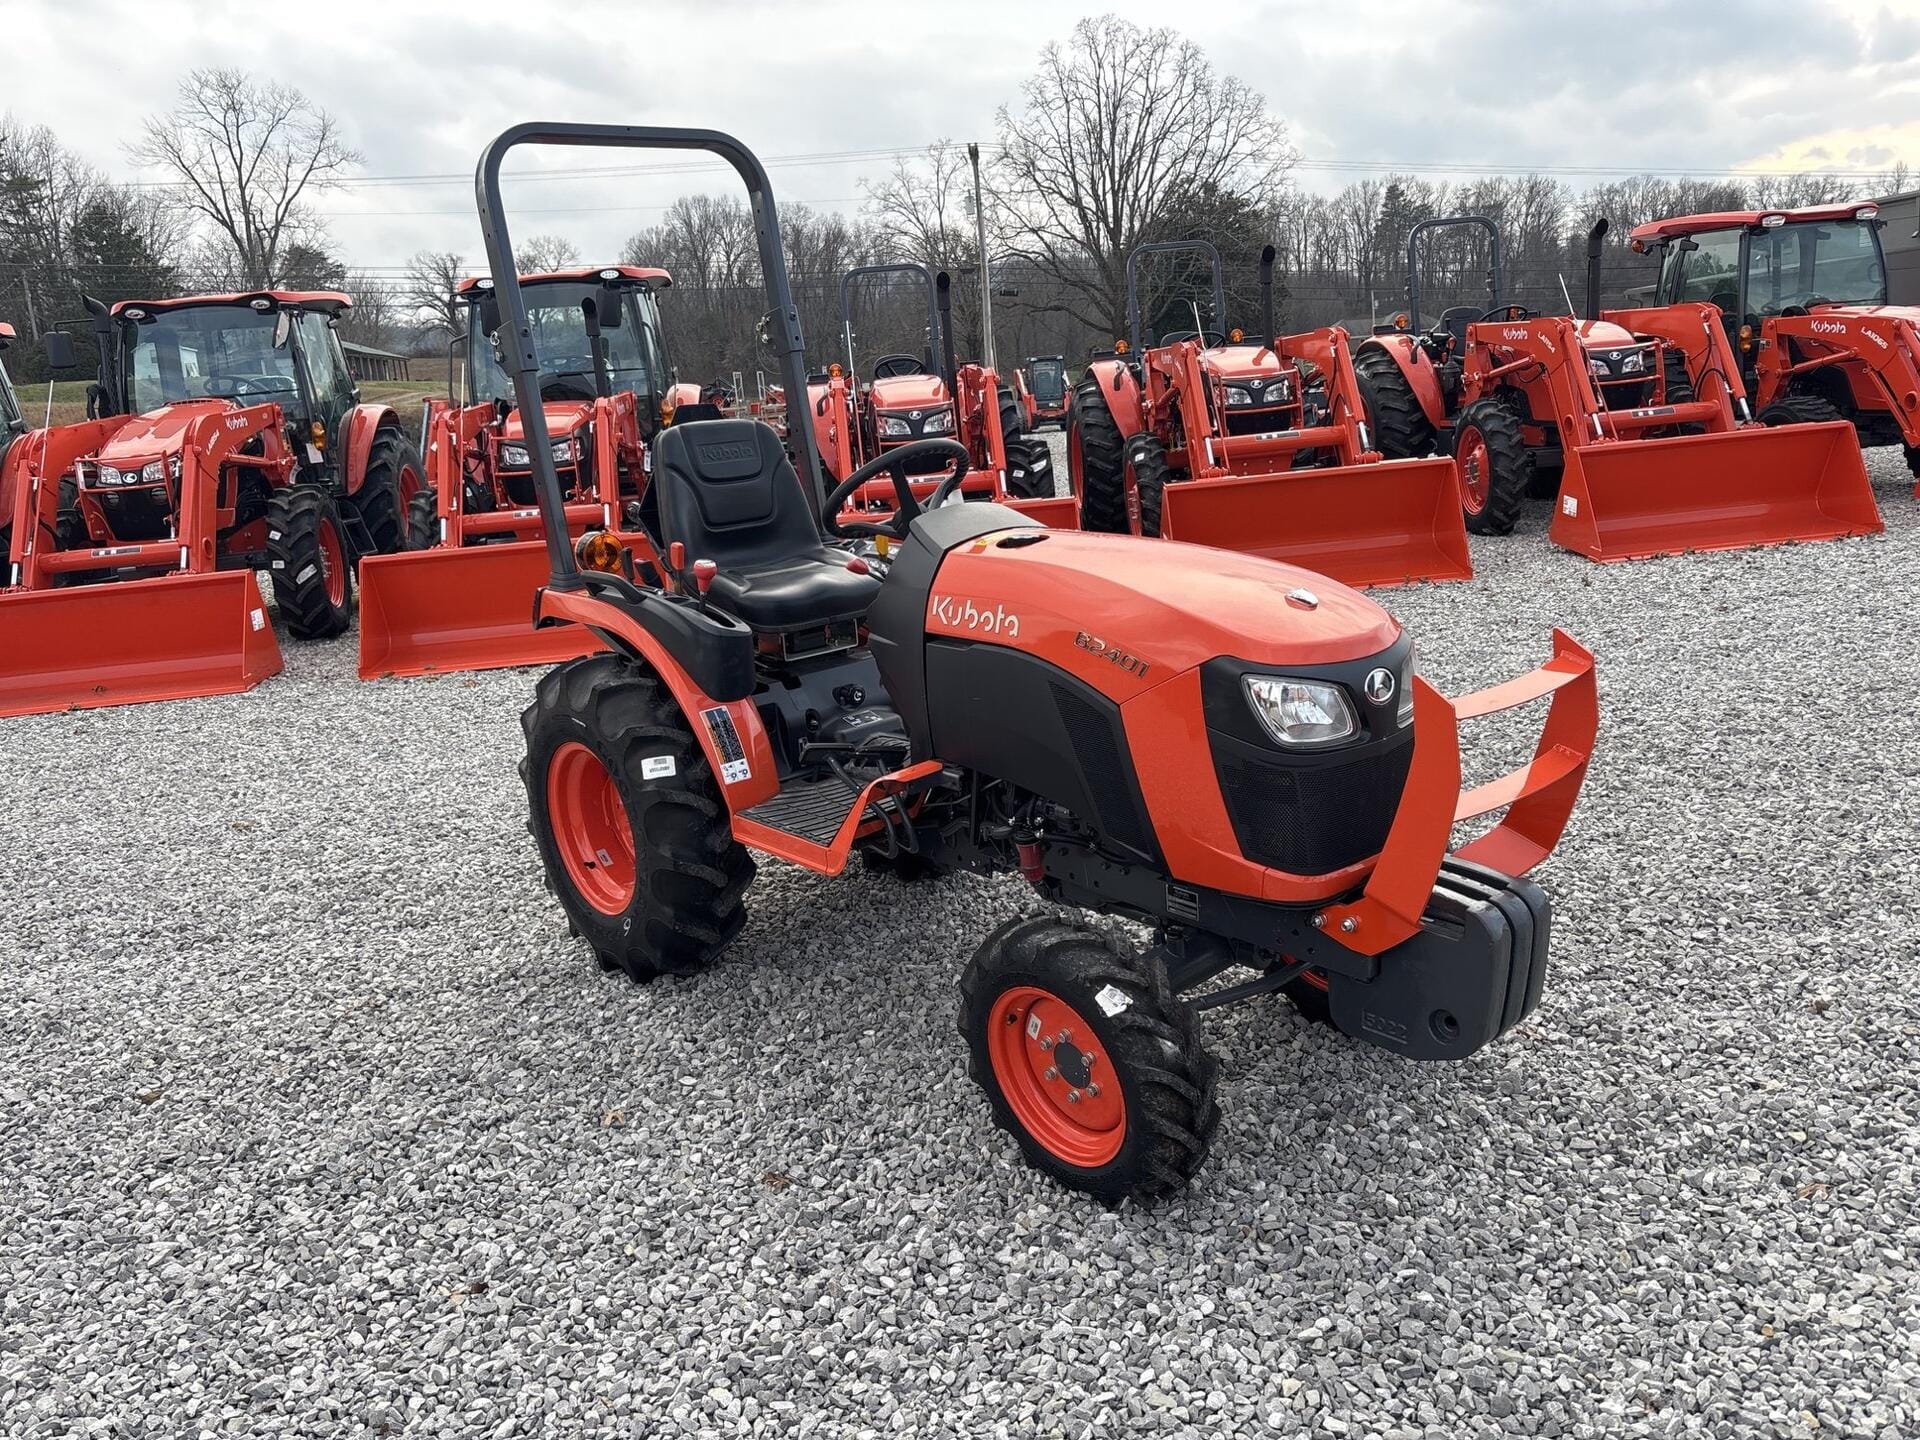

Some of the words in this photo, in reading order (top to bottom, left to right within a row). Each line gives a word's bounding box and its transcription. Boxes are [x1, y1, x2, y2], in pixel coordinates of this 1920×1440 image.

[1502, 327, 1528, 340] Kubota
[1811, 320, 1846, 334] Kubota
[225, 414, 249, 430] Kubota
[702, 446, 753, 461] Kubota
[932, 595, 1019, 637] Kubota
[1073, 631, 1151, 679] B2401
